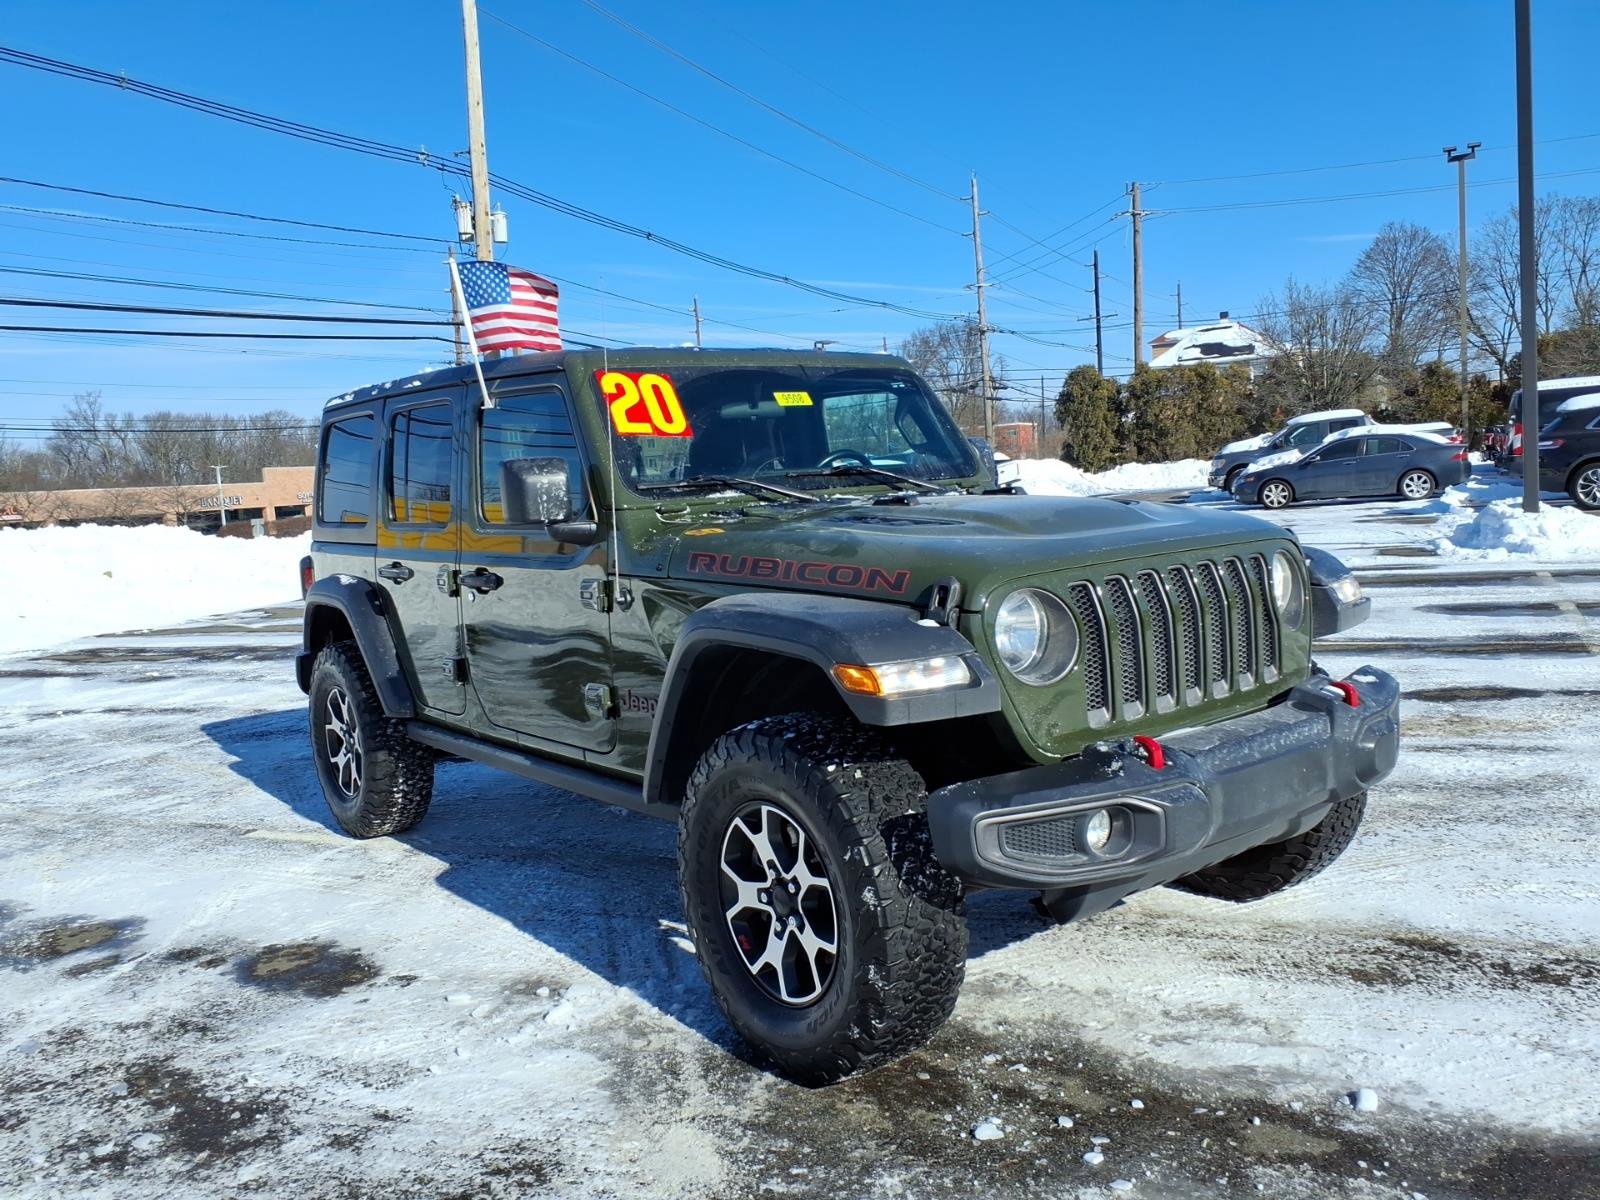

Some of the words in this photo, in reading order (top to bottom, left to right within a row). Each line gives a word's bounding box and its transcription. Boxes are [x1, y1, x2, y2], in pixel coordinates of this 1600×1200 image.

[600, 372, 687, 434] 20
[687, 552, 912, 594] RUBICON
[620, 688, 659, 719] Jeep
